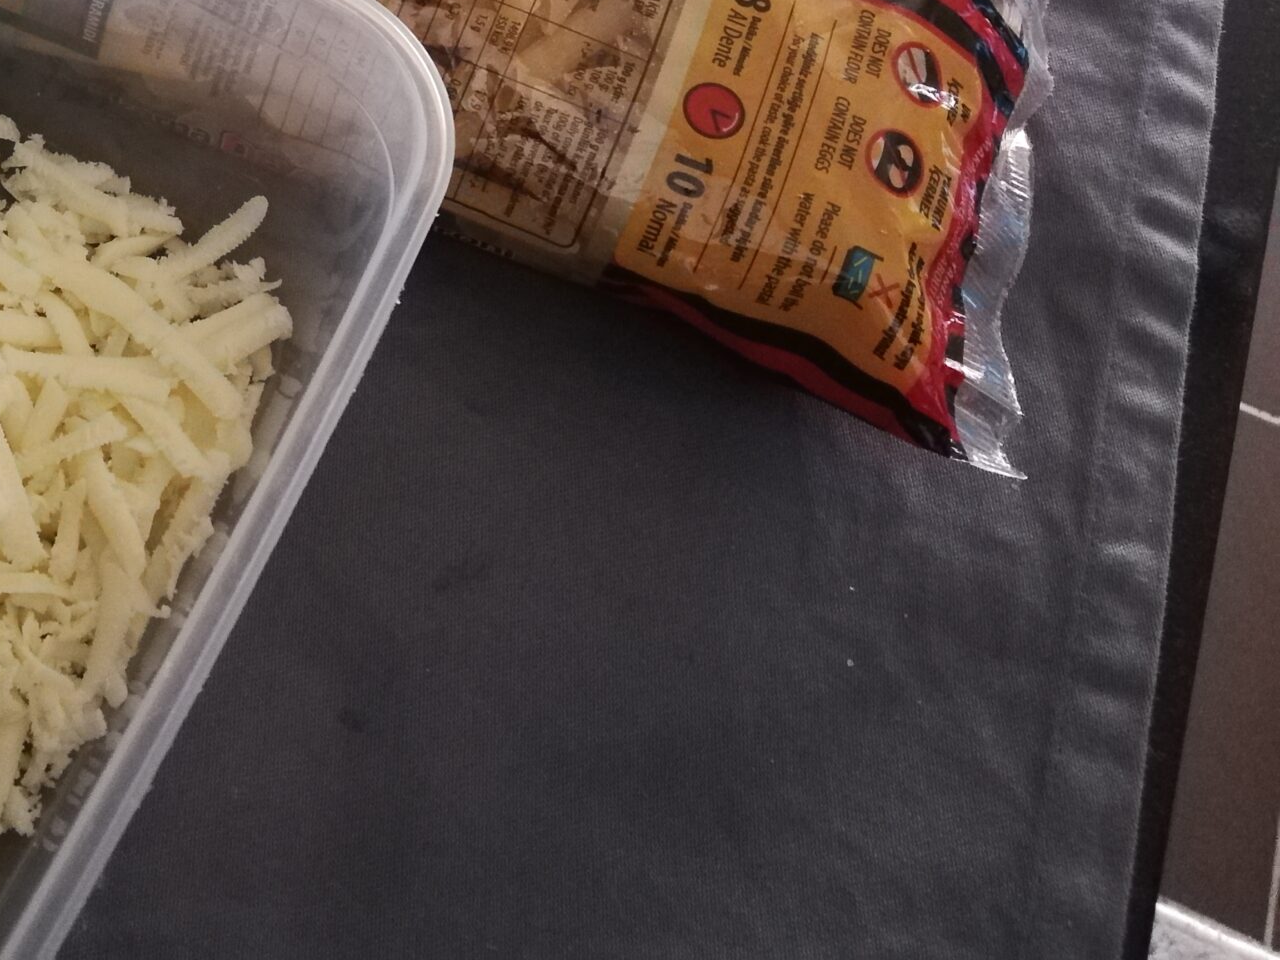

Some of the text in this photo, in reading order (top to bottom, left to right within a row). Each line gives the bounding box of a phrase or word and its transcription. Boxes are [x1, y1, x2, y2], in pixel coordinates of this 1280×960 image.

[712, 8, 747, 67] Al Dente
[844, 9, 874, 83] CONTAIN FLOUR
[865, 28, 891, 78] DOES NOT
[776, 66, 794, 92] choice
[758, 125, 771, 147] cook
[779, 112, 793, 135] göre
[814, 96, 849, 173] CONTAIN EGGS
[752, 146, 766, 162] the
[837, 115, 866, 170] DOES NOT
[666, 154, 712, 197] 10
[743, 161, 759, 186] pasta
[757, 176, 773, 199] süre
[794, 192, 814, 227] water
[816, 201, 840, 238] Please
[637, 198, 676, 255] Normal
[782, 227, 801, 255] with
[809, 240, 826, 255] do
[773, 256, 791, 275] the
[798, 257, 817, 278] not
[789, 278, 811, 298] boil
